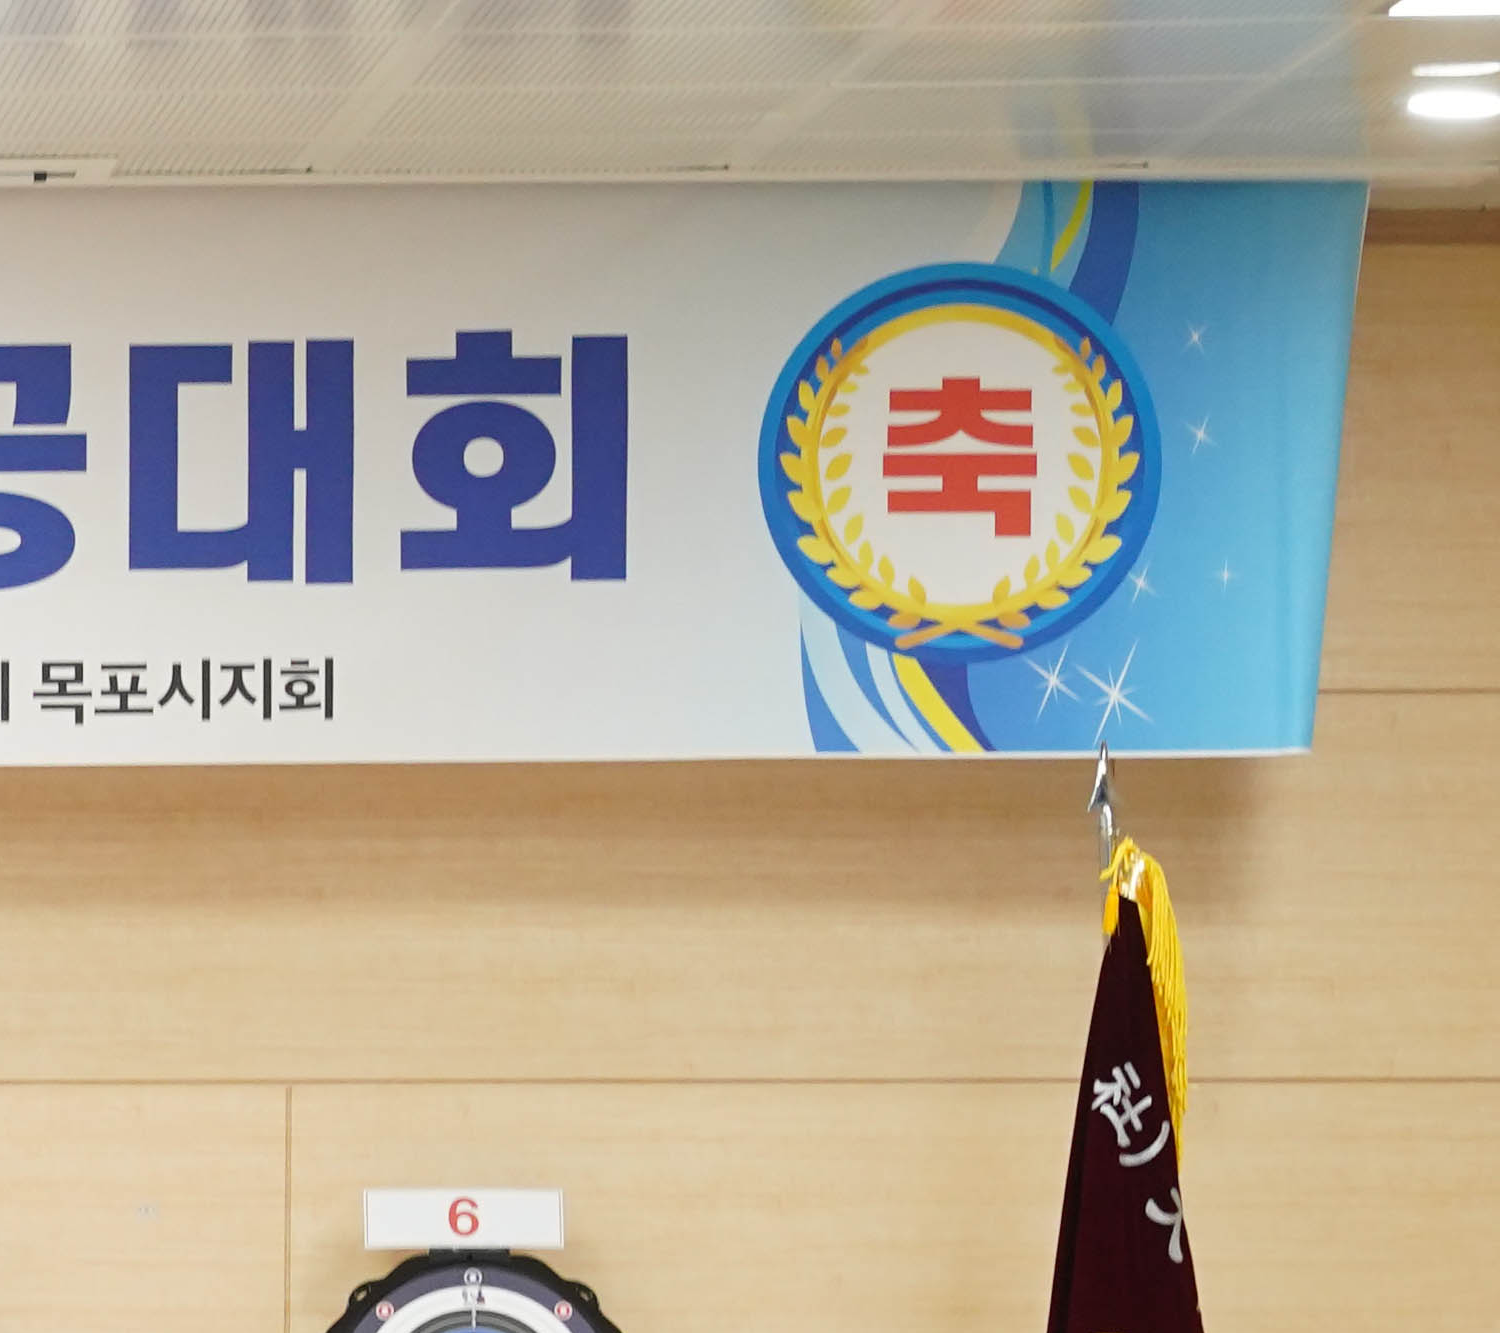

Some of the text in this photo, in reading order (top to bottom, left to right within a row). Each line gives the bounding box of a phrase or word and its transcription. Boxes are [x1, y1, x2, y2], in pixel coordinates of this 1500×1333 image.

[882, 375, 1038, 537] 축
[32, 656, 334, 726] 목포시지회
[448, 1197, 480, 1237] 6
